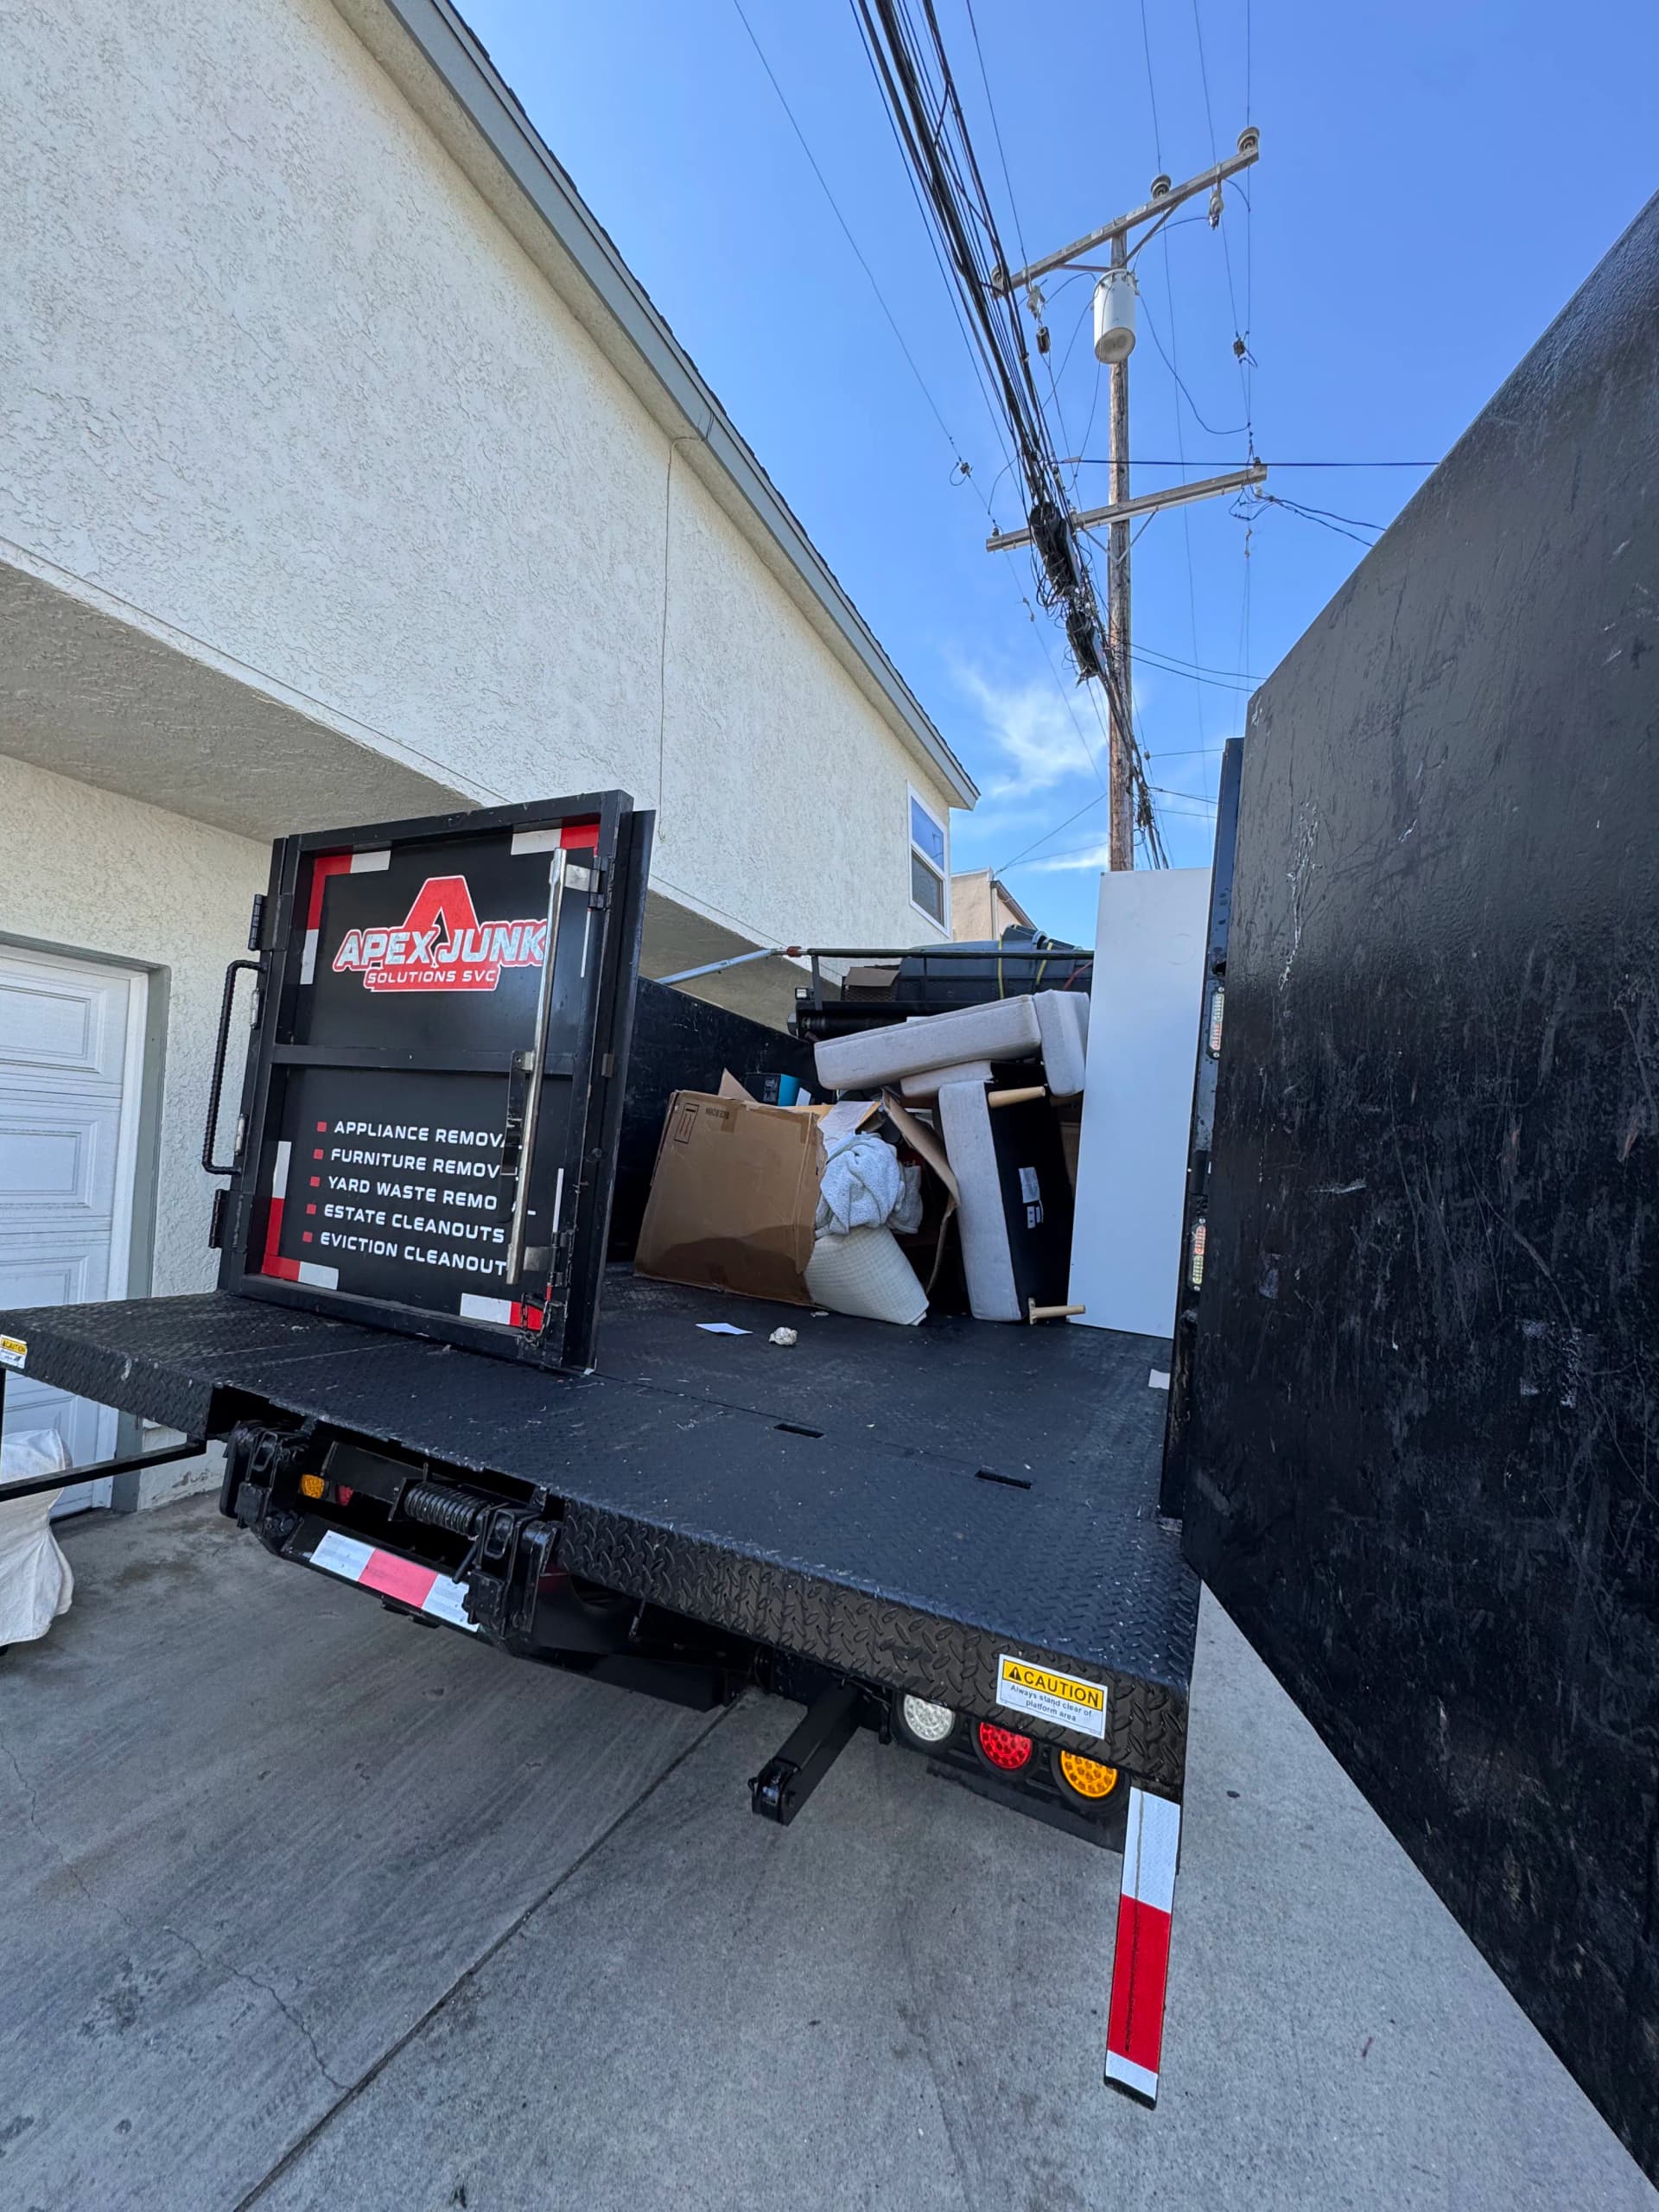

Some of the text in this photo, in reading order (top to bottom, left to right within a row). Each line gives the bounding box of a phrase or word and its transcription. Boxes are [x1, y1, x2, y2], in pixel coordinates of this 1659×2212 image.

[336, 925, 548, 966] APEX JUNK
[366, 969, 498, 984] SOLUTIONS SVC
[334, 1121, 523, 1150] APPLIANCE REMOV
[331, 1148, 518, 1181] FURNITURE REMOV
[328, 1175, 371, 1194] YARD
[377, 1182, 437, 1203] WASTE
[324, 1204, 505, 1243] ESTATE CLEANOUTS
[320, 1231, 507, 1276] EVICTION CLEANOUT
[1010, 1684, 1093, 1718] Always stand clear of
[1024, 1671, 1099, 1708] CAUTION
[1026, 1699, 1077, 1722] platform area
